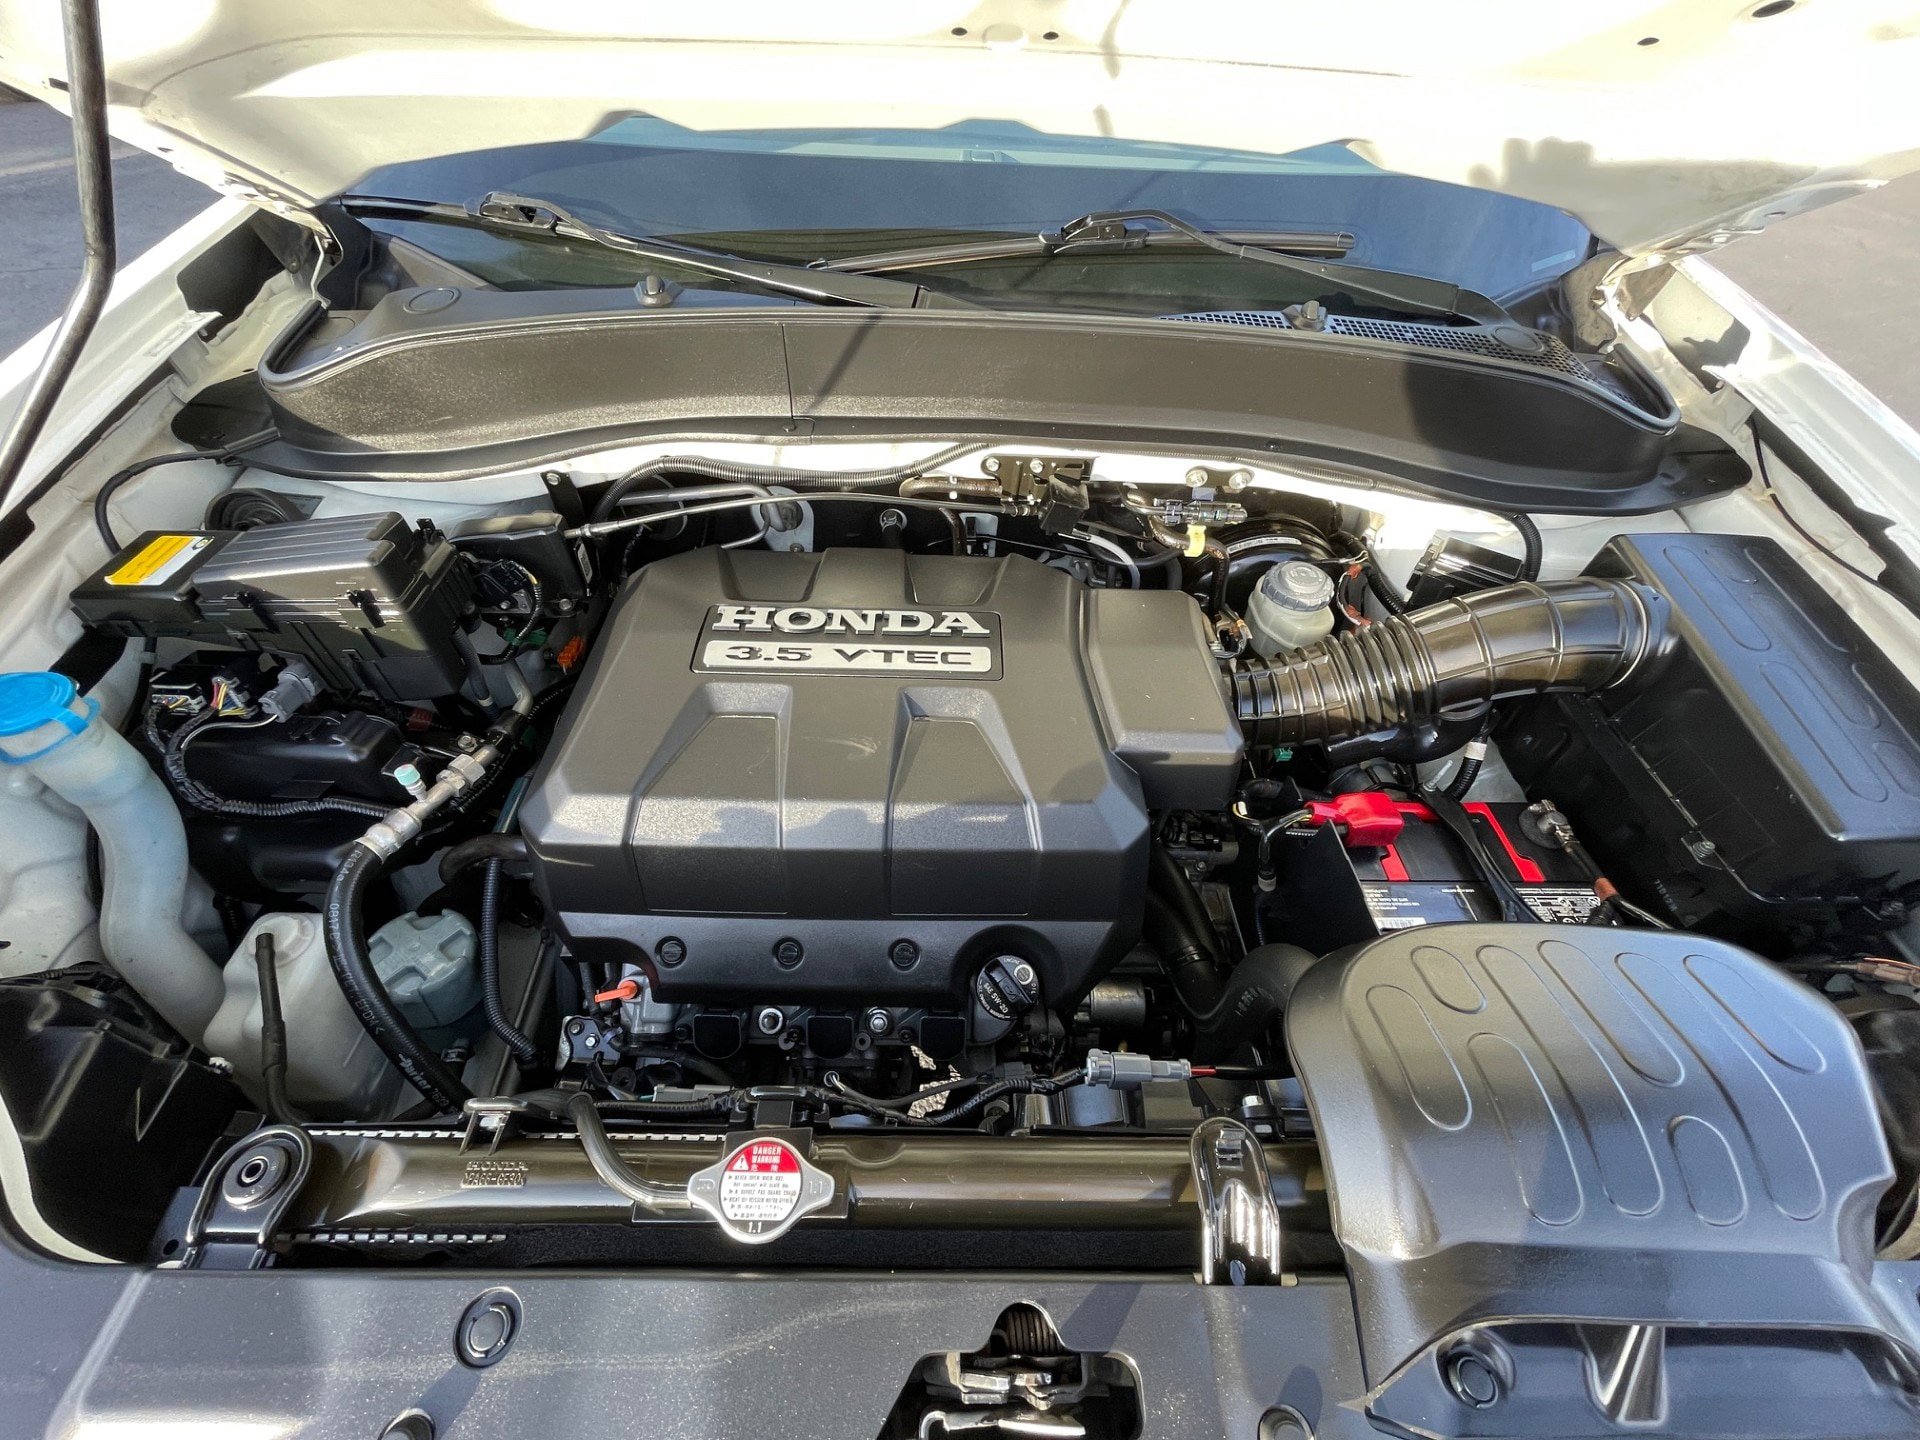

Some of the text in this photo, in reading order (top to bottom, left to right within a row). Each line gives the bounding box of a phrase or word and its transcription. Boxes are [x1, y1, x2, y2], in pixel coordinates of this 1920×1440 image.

[711, 605, 990, 637] HONDA
[725, 645, 972, 665] 3.5 VTEC
[983, 982, 994, 995] SAE
[752, 1145, 783, 1155] DANGER
[466, 1161, 528, 1171] HONDA
[809, 1180, 823, 1194] 1.1
[748, 1221, 762, 1233] 1.1
